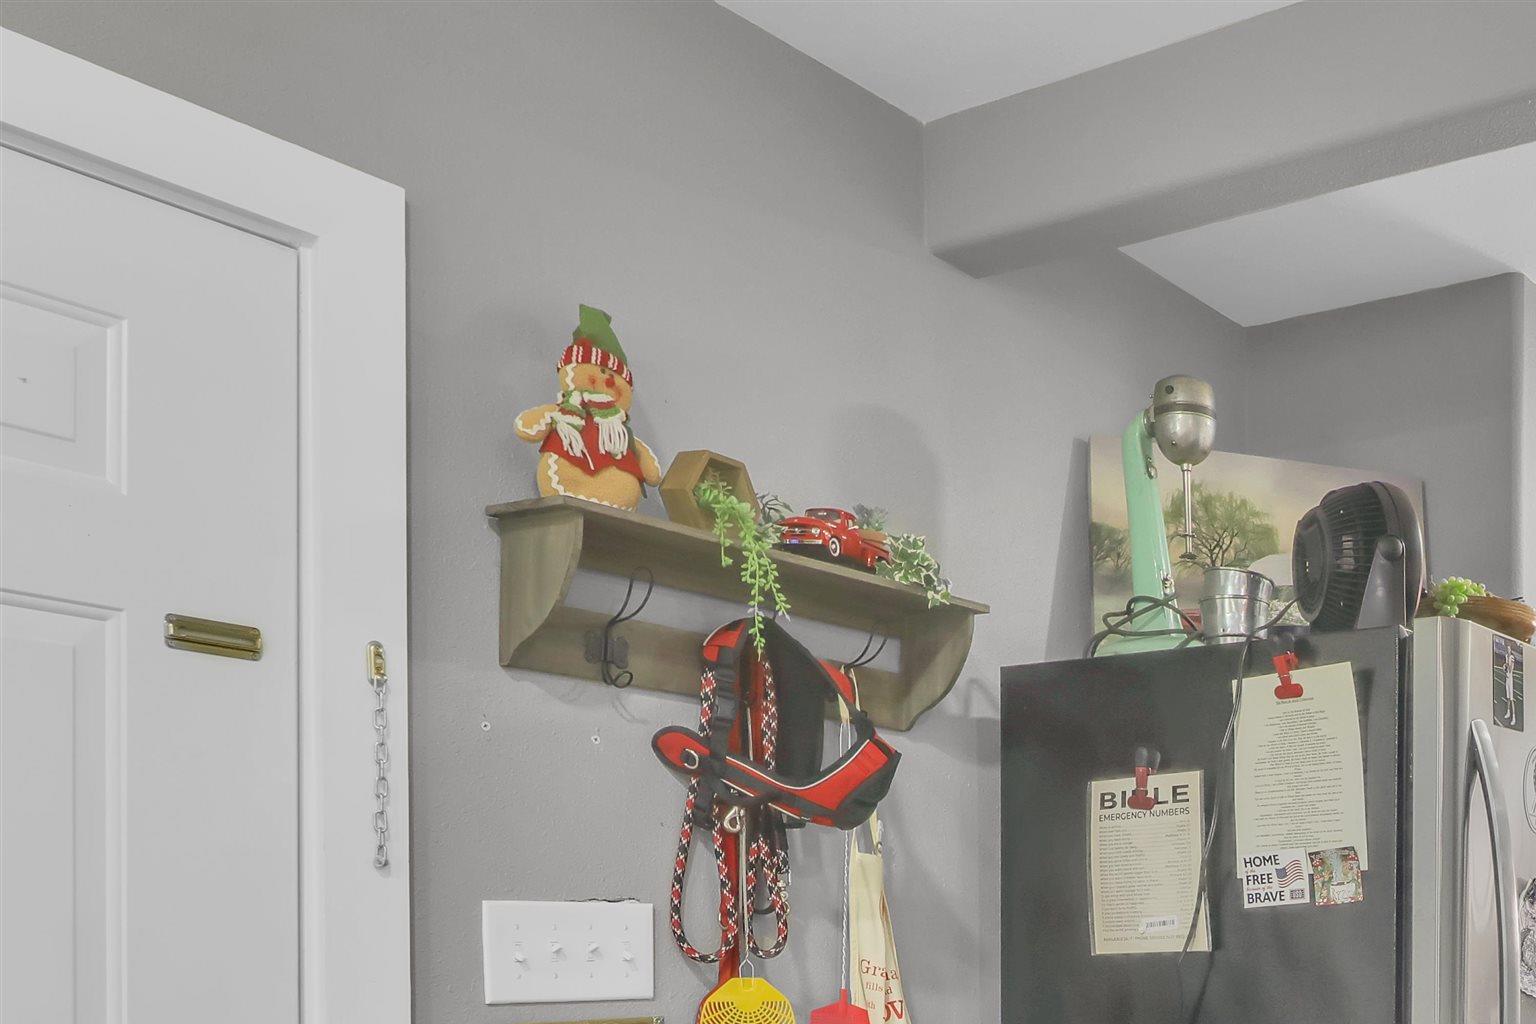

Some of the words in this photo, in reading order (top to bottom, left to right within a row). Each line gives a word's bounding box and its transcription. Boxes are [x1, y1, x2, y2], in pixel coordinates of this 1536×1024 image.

[1099, 784, 1190, 811] BILE
[1098, 811, 1148, 822] EMERGENCY
[1149, 806, 1190, 818] NUMBERS
[1243, 854, 1280, 868] HOME
[1246, 873, 1273, 885] FREE
[1247, 890, 1285, 904] BRAVE
